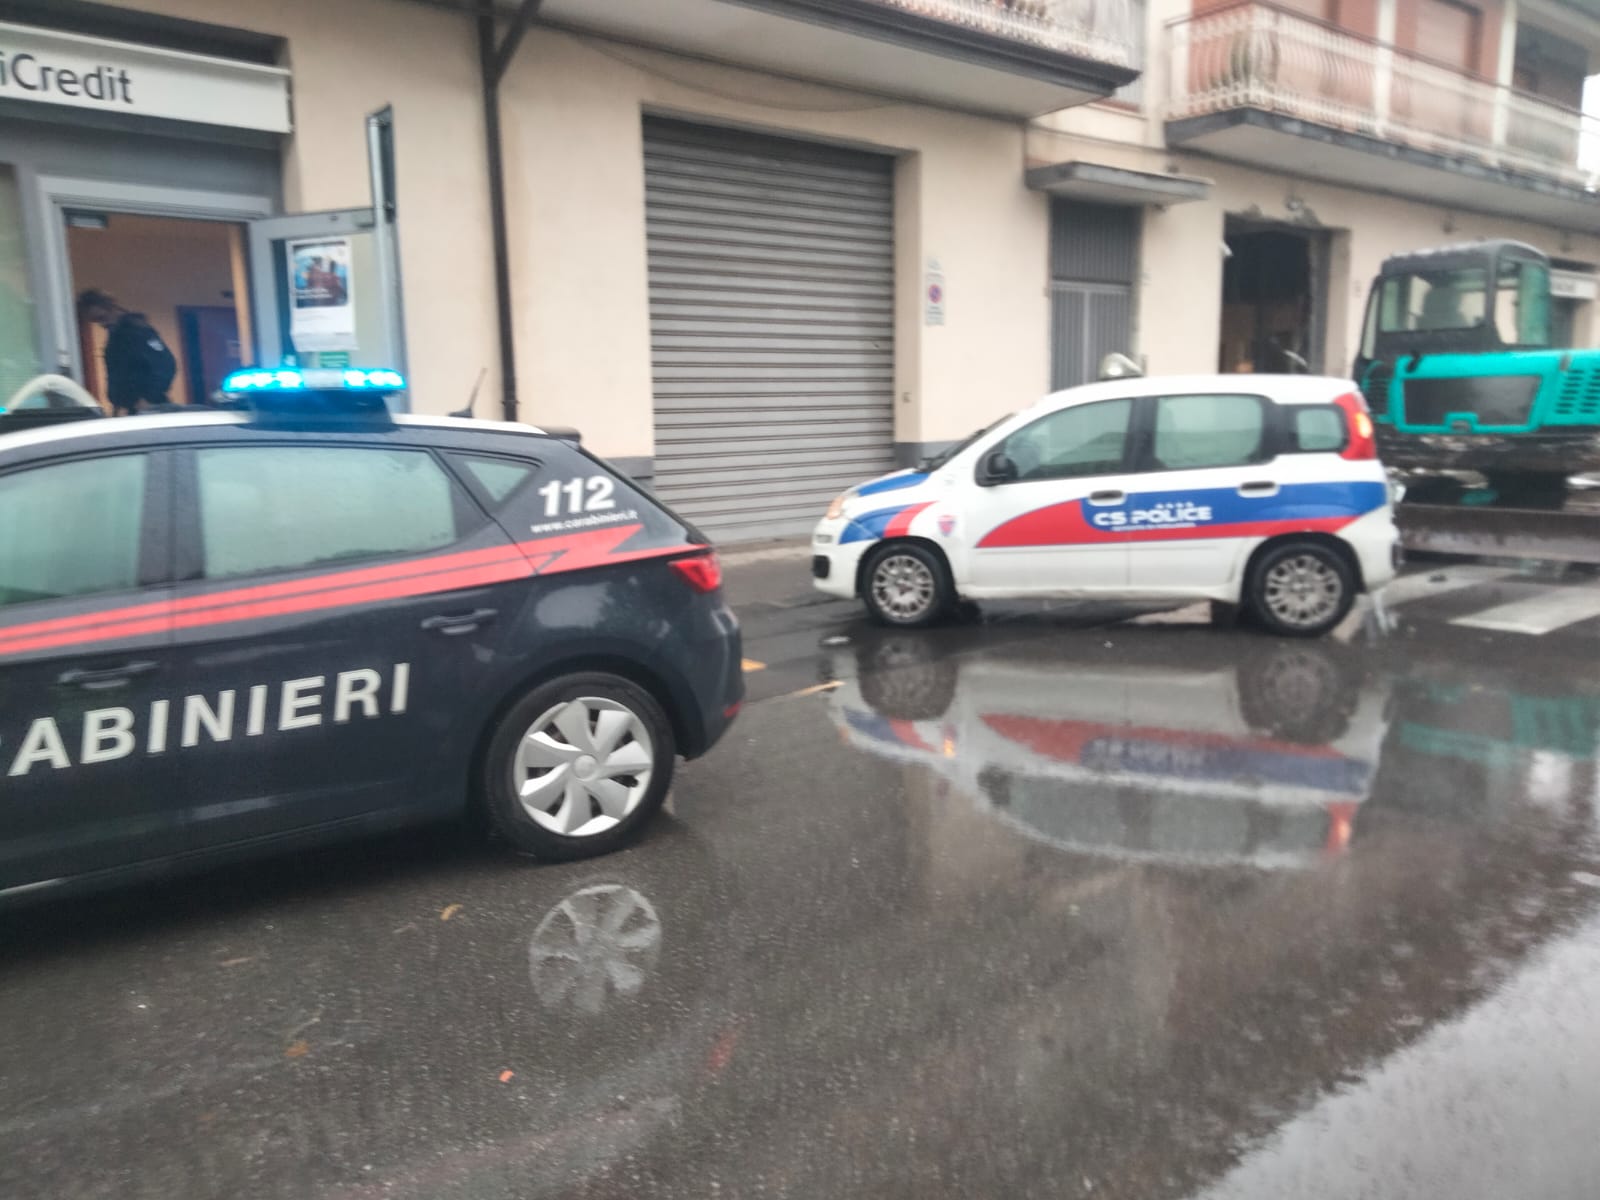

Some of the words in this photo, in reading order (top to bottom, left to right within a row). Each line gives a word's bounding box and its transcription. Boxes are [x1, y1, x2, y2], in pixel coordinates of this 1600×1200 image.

[0, 51, 134, 104] iCredit
[539, 476, 616, 517] 112
[1093, 511, 1127, 526] CS
[1130, 506, 1213, 524] POLICE
[0, 662, 411, 776] ABINIERI
